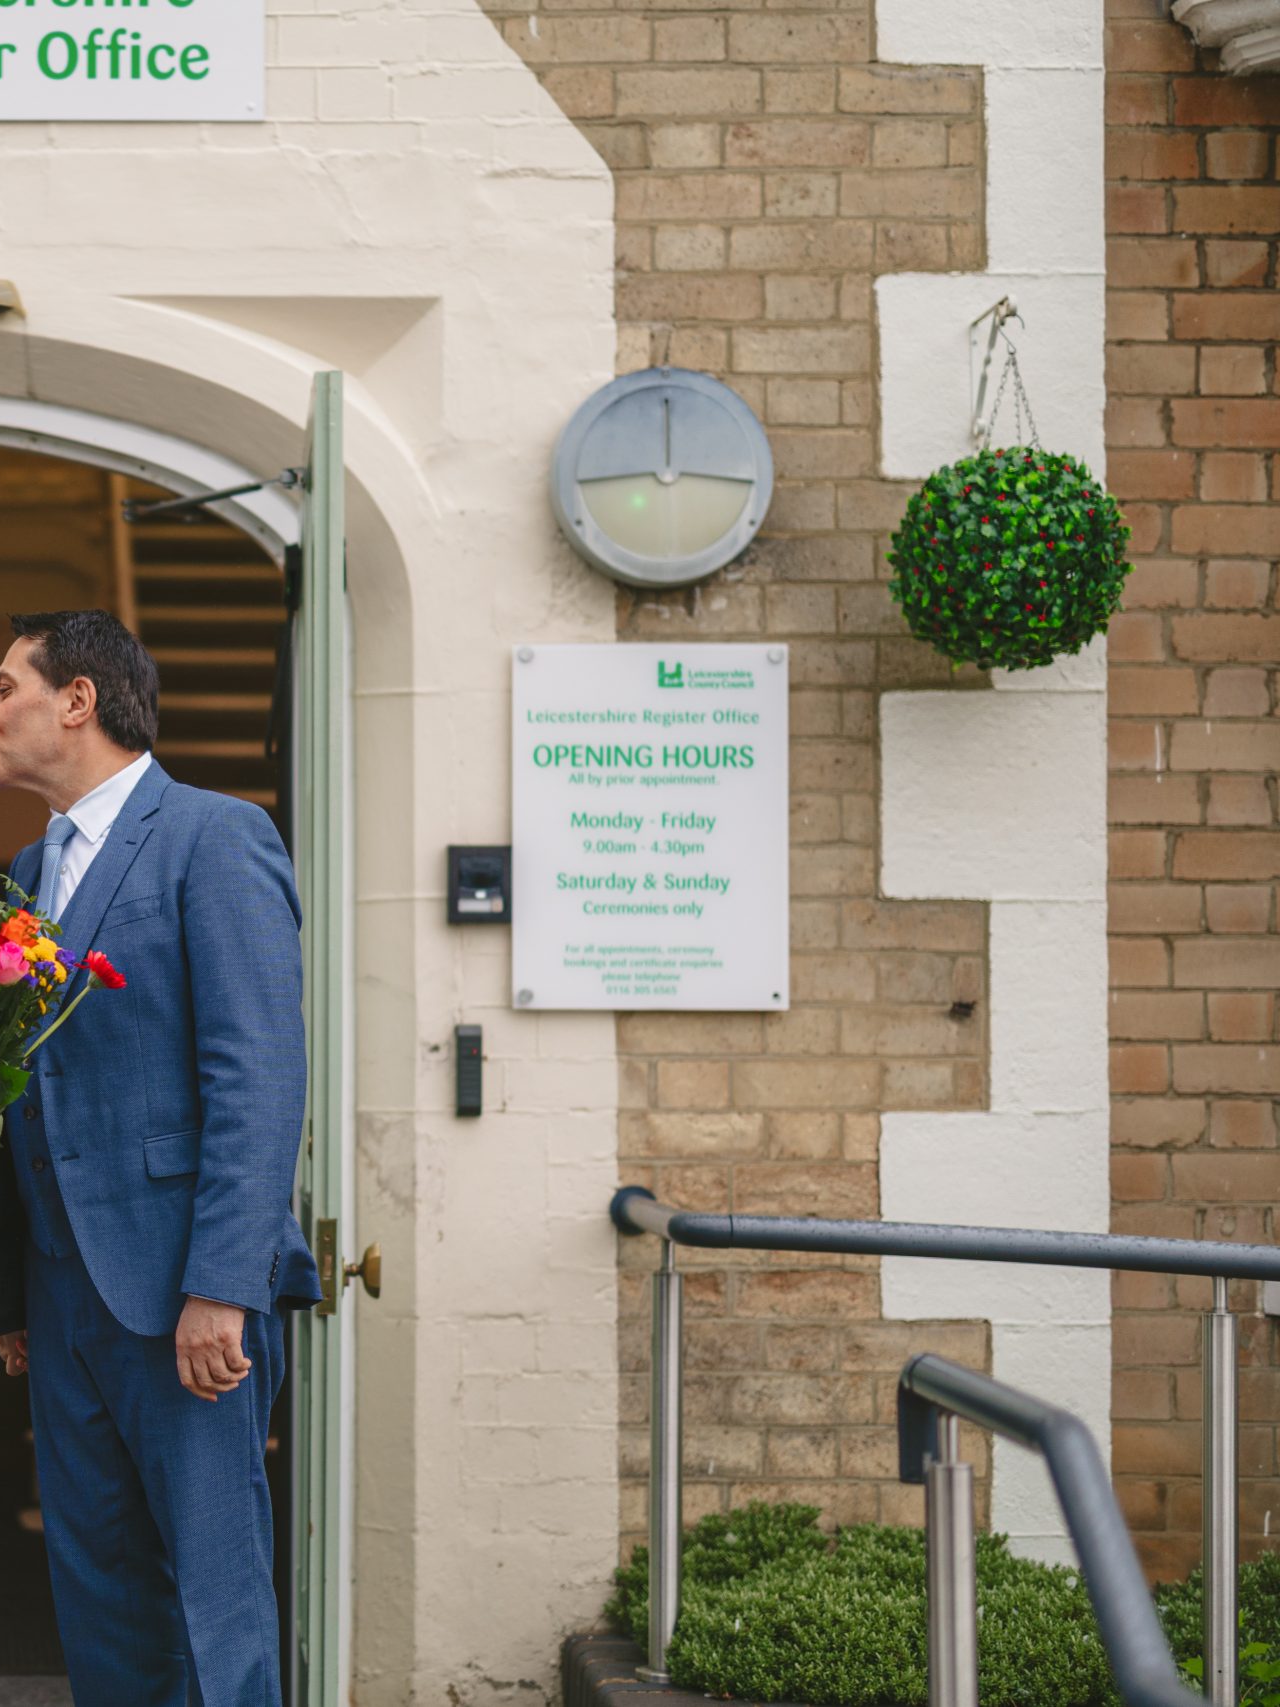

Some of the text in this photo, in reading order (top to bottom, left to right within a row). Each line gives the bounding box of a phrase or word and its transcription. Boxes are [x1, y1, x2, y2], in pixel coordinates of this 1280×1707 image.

[36, 28, 210, 80] Office
[687, 669, 753, 679] Leicestershire
[687, 679, 754, 689] County Council
[527, 708, 760, 727] Leicestershire Register Office
[532, 744, 755, 768] OPENING HOURS
[568, 773, 720, 787] All by prior appointment.
[570, 811, 644, 833] Monday
[661, 811, 717, 833] Friday
[582, 840, 637, 855] 9.00am
[650, 840, 705, 857] 4.30pm
[556, 872, 730, 894] Saturday & Sunday
[582, 901, 704, 918] Ceremonies only
[564, 944, 580, 954] For
[583, 944, 594, 954] all
[563, 958, 724, 969] bookings and certificate enquiries
[601, 972, 681, 983] please telephone
